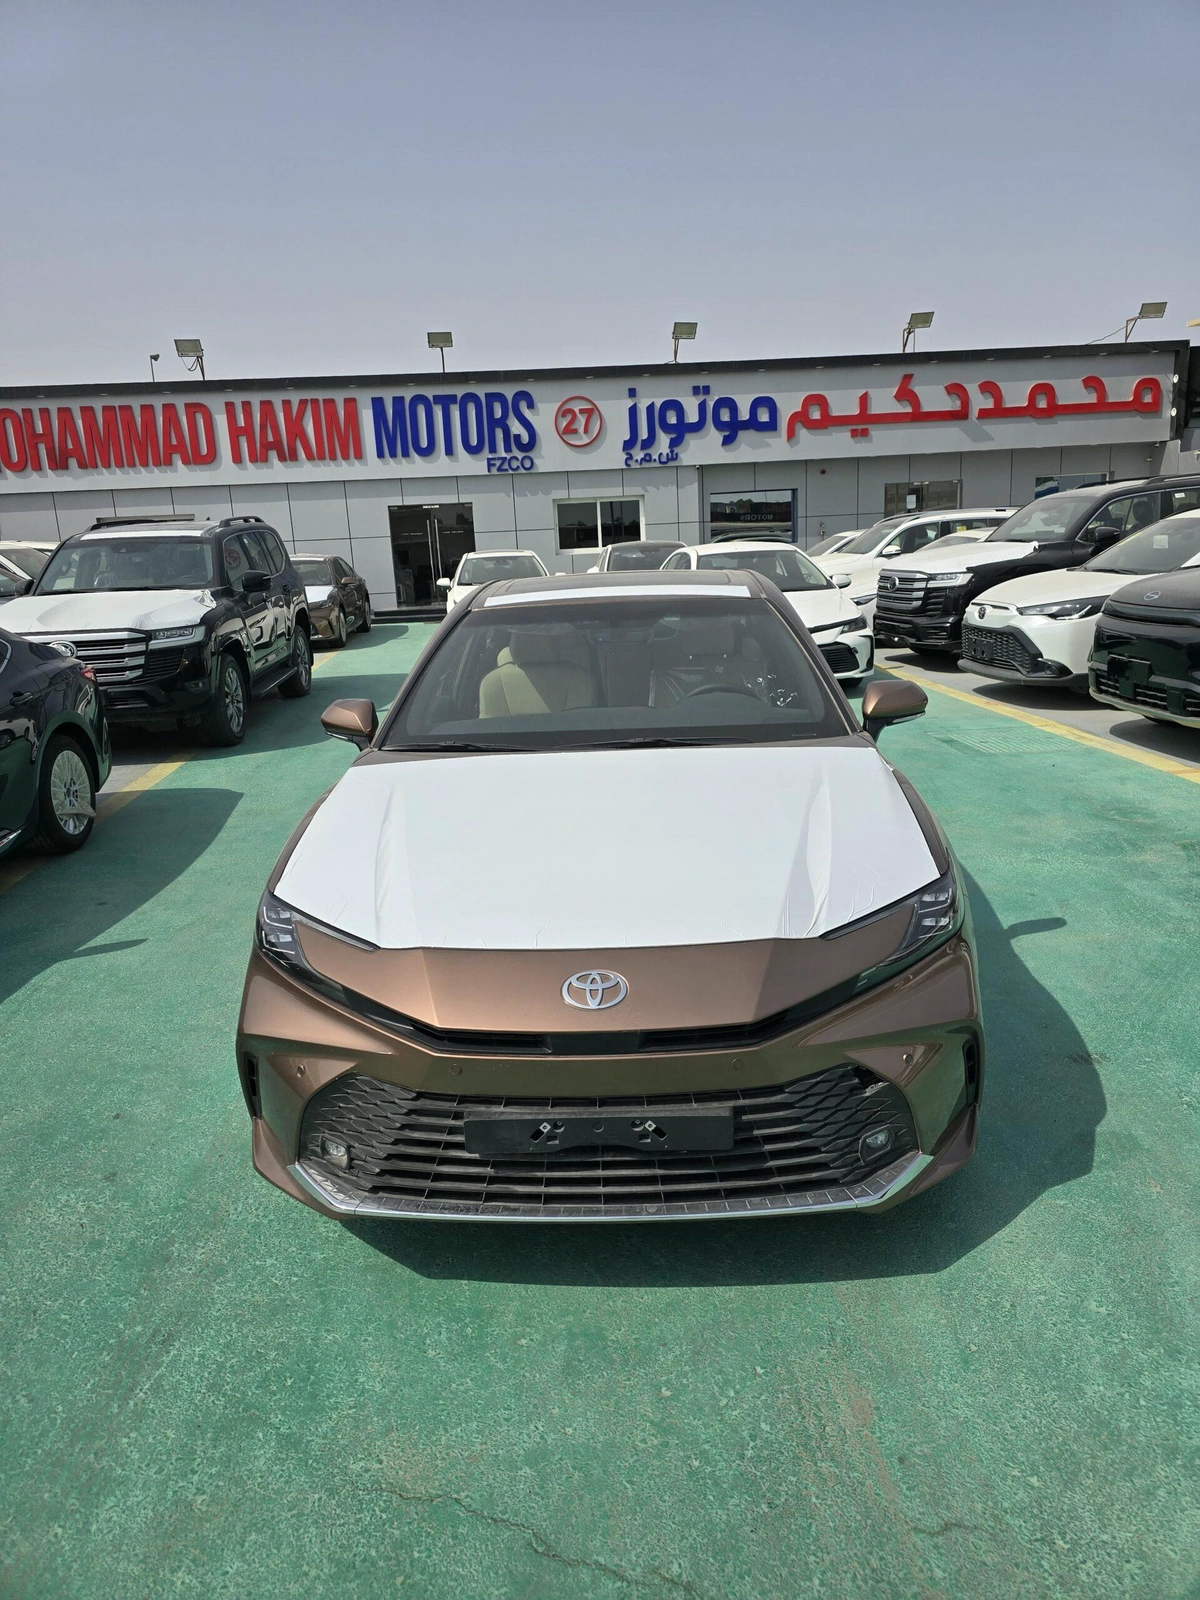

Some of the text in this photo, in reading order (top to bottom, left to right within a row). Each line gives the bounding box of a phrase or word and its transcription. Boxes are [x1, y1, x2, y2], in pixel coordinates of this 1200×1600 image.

[0, 390, 537, 473] OHAMMAD HAKIM MOTORS
[561, 407, 596, 434] 27
[622, 374, 1162, 452] محمد حكيم موتورز
[486, 455, 534, 473] FZCO
